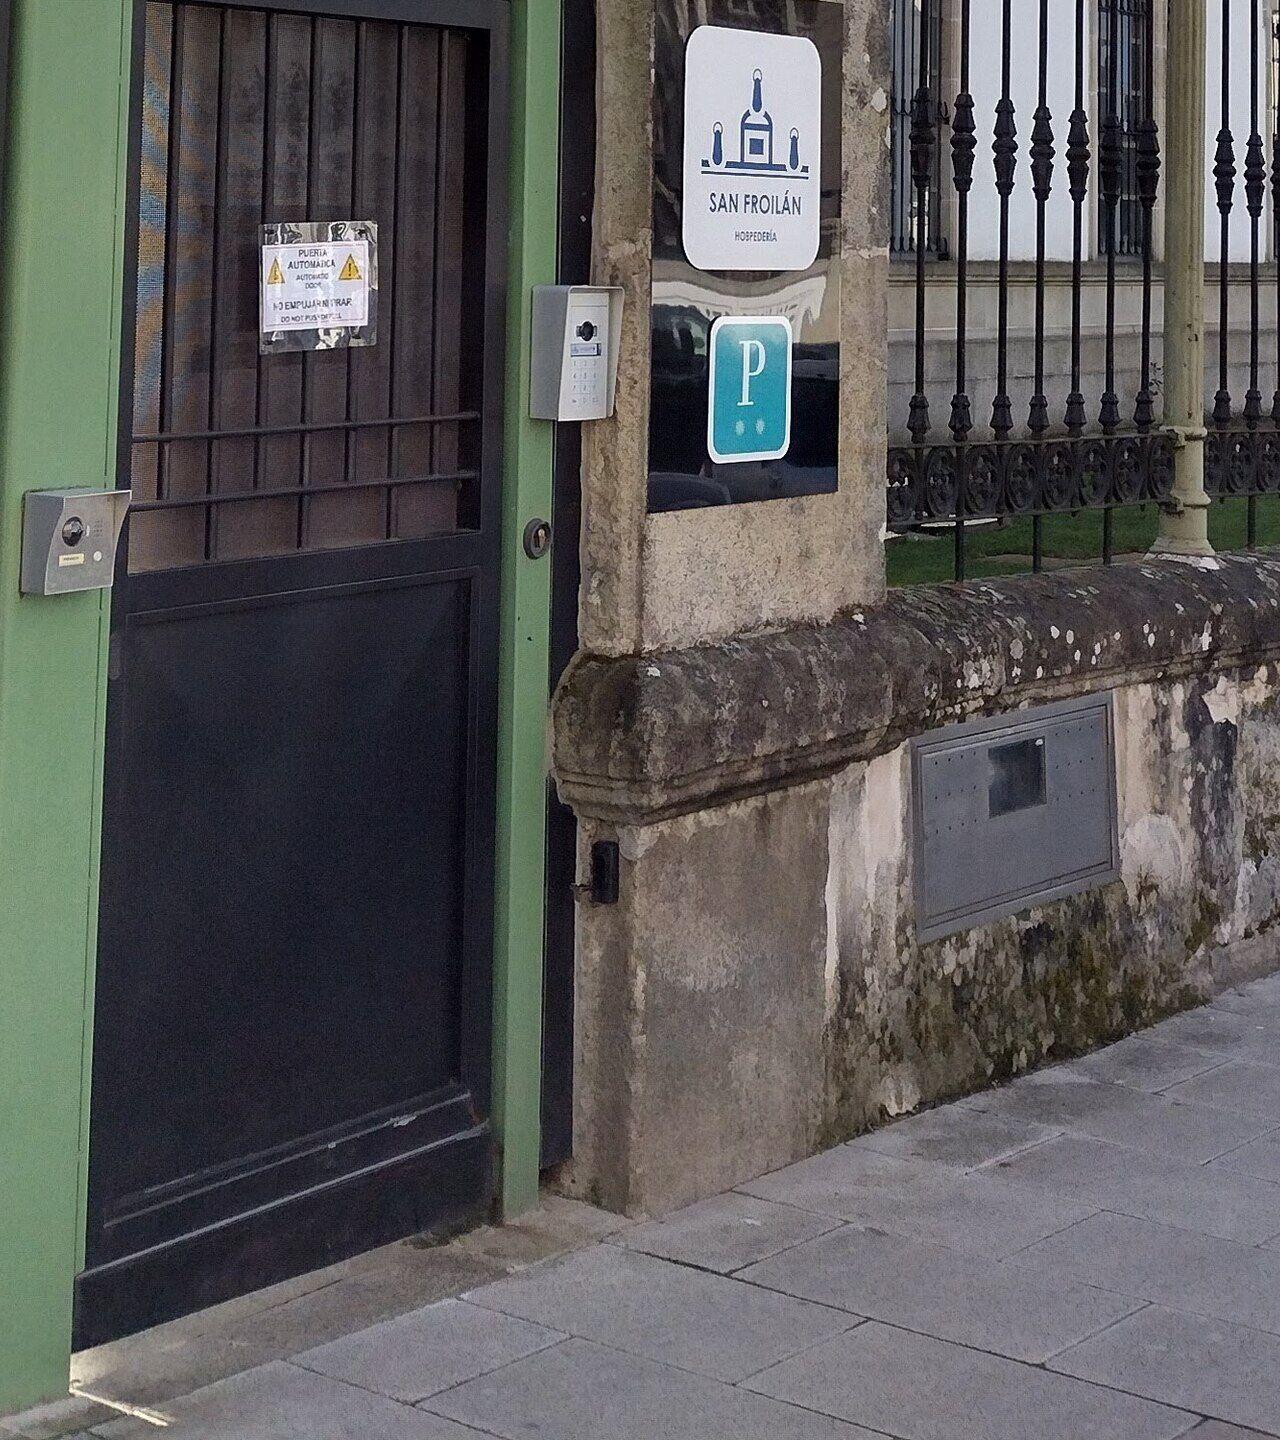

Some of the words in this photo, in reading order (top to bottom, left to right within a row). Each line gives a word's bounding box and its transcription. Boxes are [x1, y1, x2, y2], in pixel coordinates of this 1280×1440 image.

[709, 192, 738, 213] SAN
[743, 189, 801, 216] FROILÁN
[736, 339, 766, 407] P
